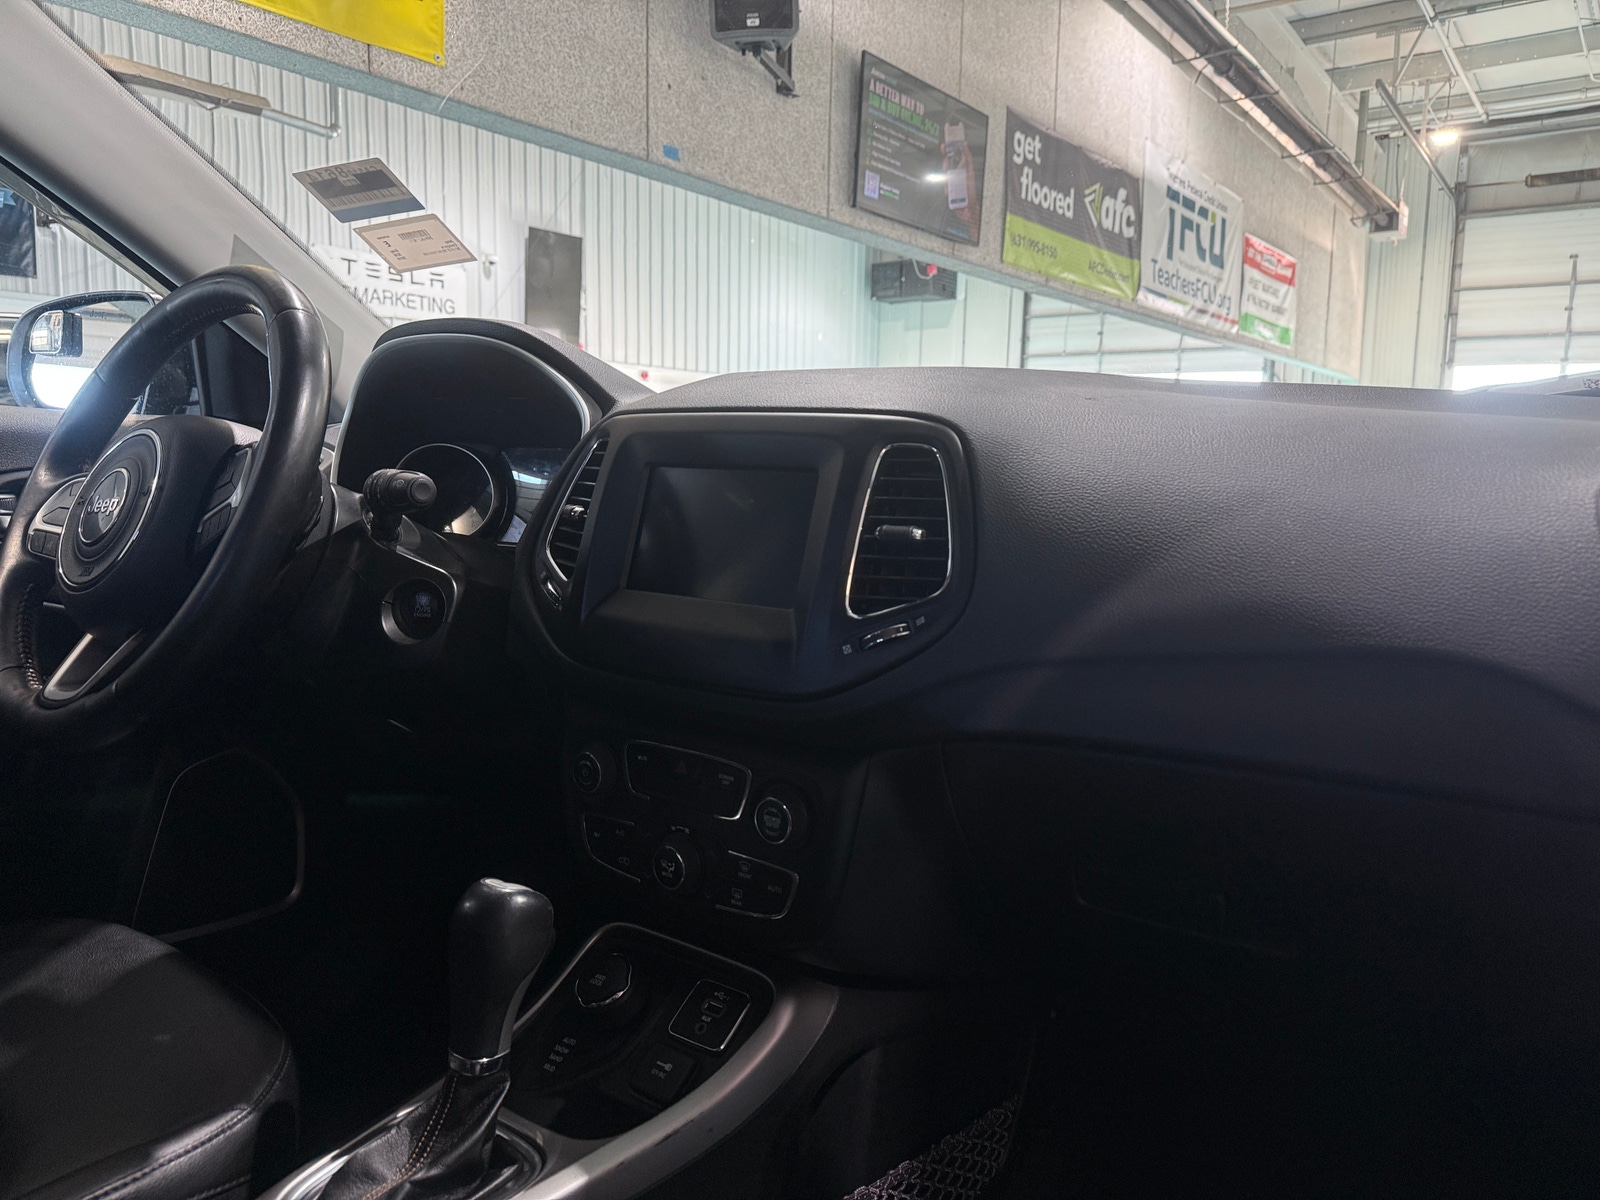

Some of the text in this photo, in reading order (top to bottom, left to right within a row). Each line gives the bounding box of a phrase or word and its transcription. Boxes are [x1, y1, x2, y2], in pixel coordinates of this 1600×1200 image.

[875, 80, 900, 105] BETTER
[1012, 130, 1042, 165] get
[1020, 165, 1075, 220] floored
[1100, 186, 1137, 239] afc
[1165, 184, 1227, 270] TFCU
[1151, 257, 1232, 316] TeachersFCU.org
[87, 496, 119, 517] Jeep
[767, 884, 783, 894] AUTO
